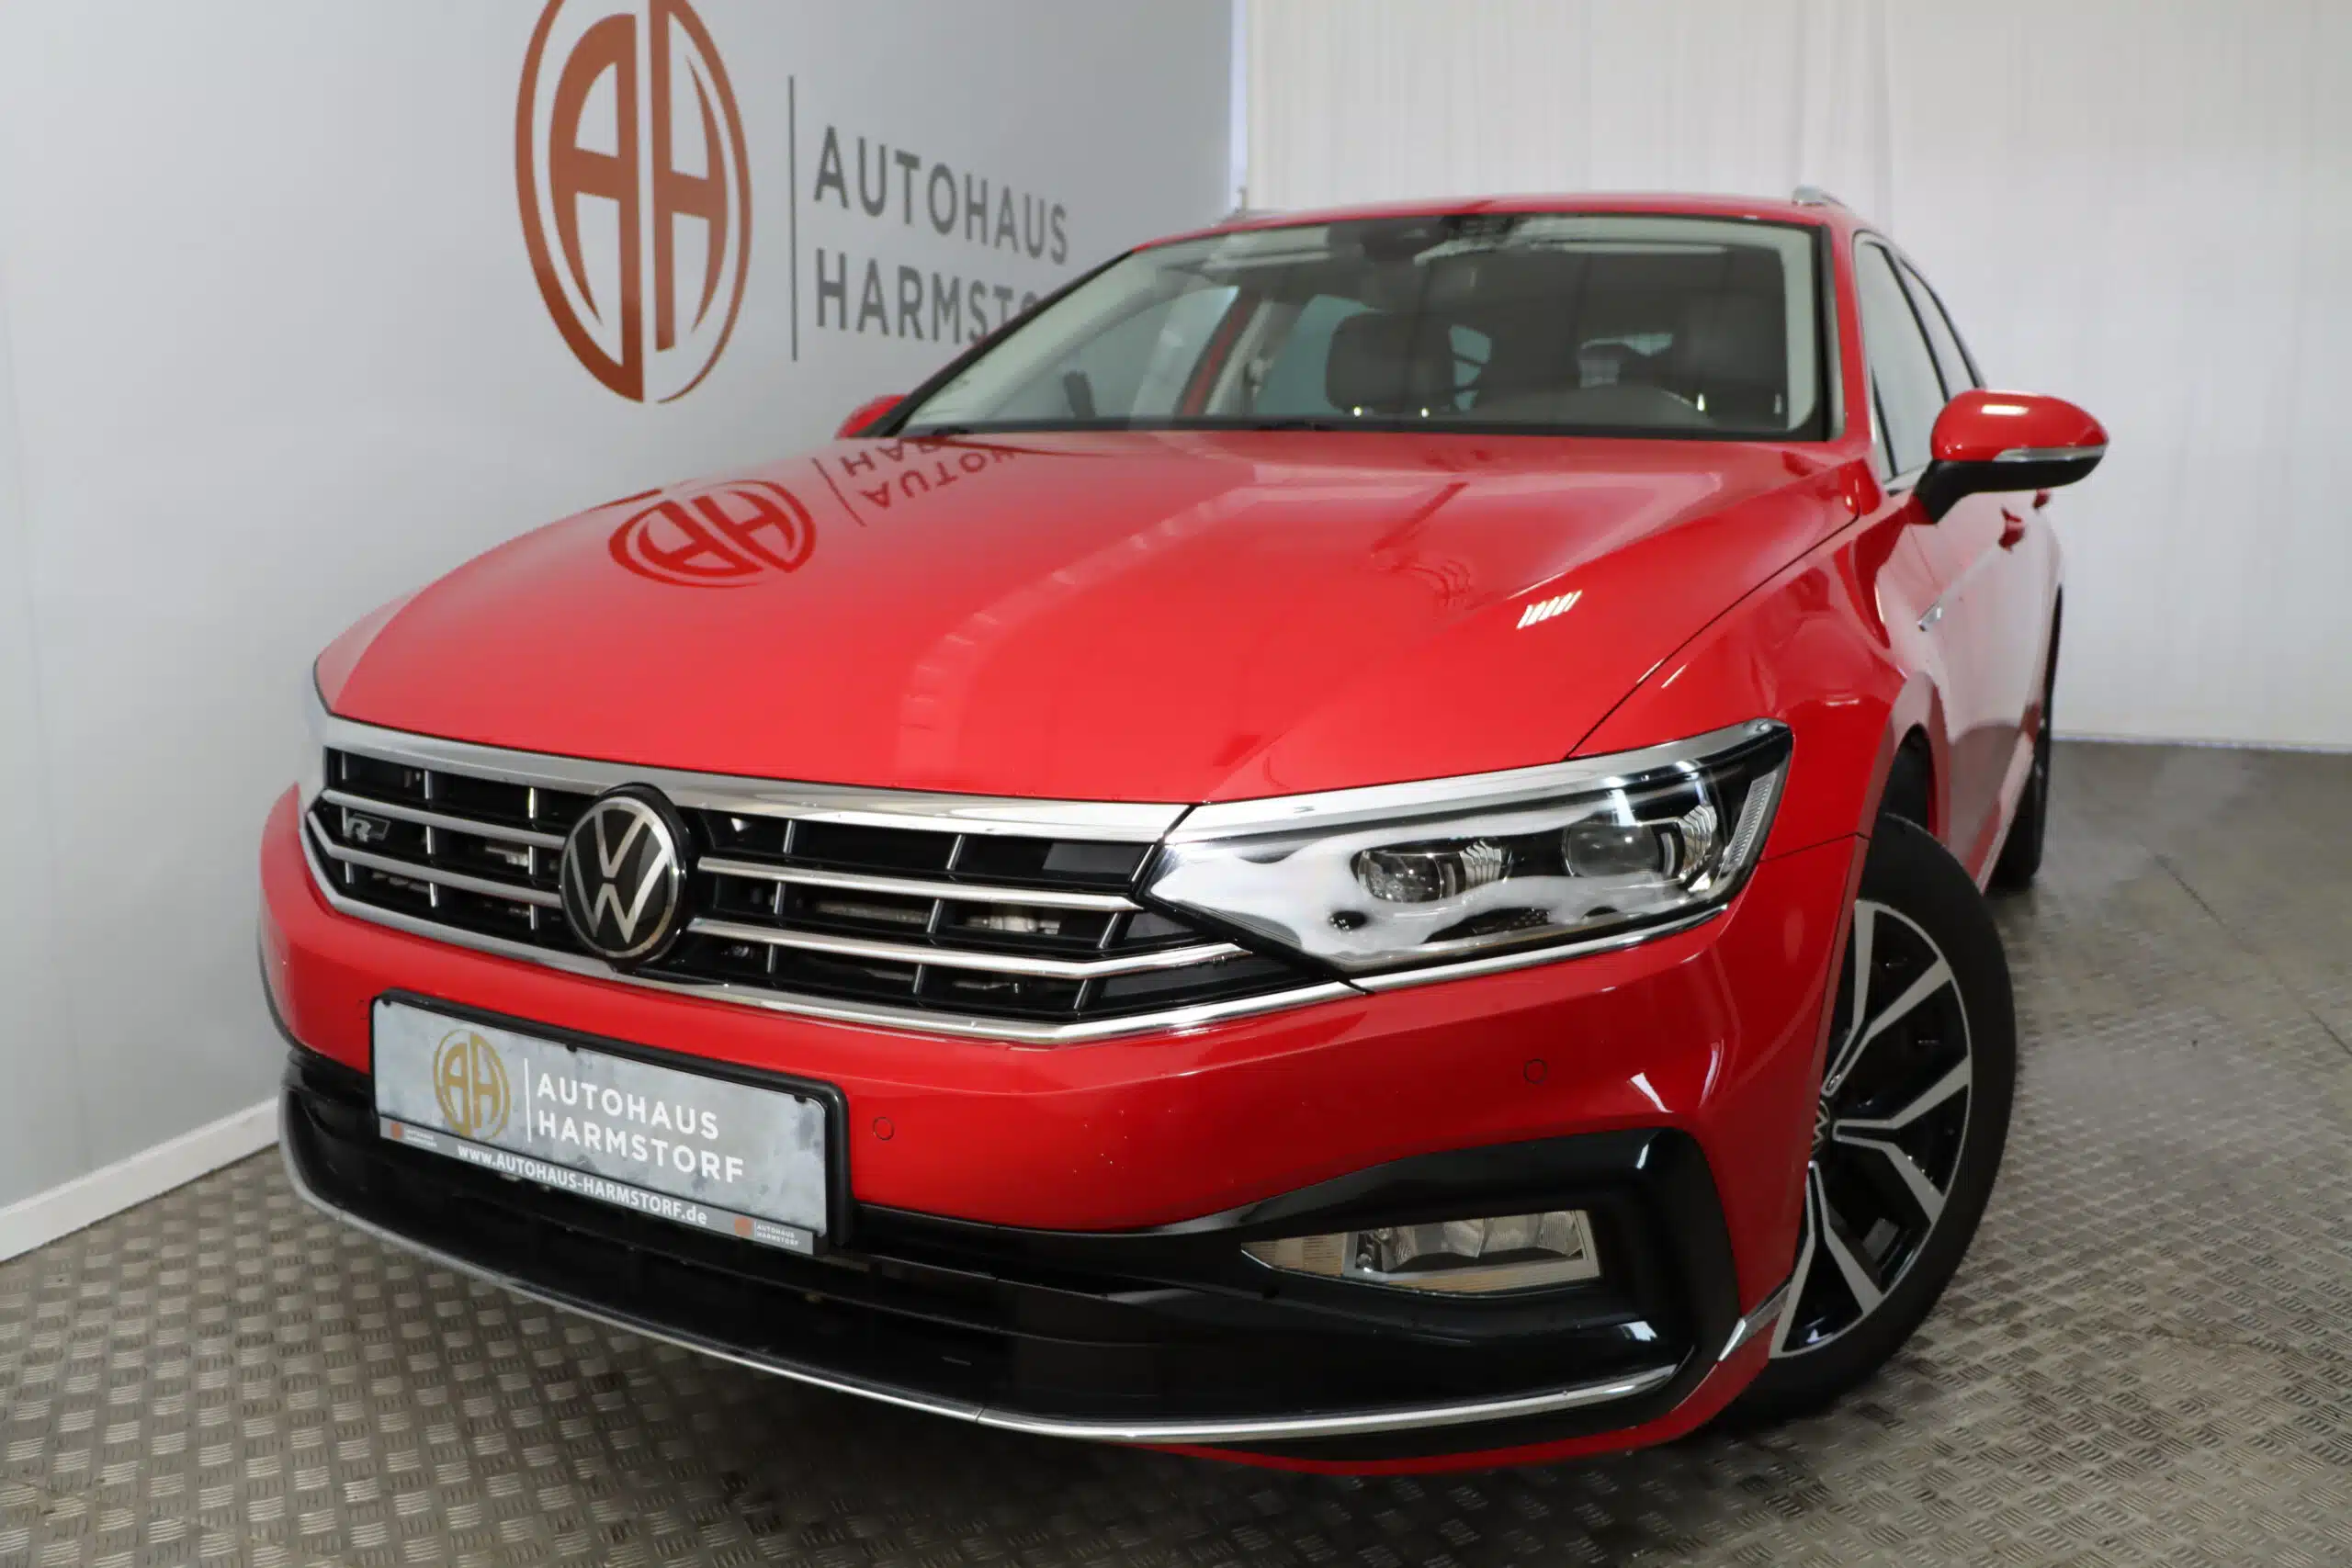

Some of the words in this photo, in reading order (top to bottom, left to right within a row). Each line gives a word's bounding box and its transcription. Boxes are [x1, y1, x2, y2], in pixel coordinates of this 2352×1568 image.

[814, 126, 1069, 265] AUTOHAUS
[537, 1073, 718, 1140] AUTOHAUS
[538, 1110, 743, 1183] HARMSTORF
[458, 1145, 707, 1225] www.AUTOHAUS-HARMSTORF.de
